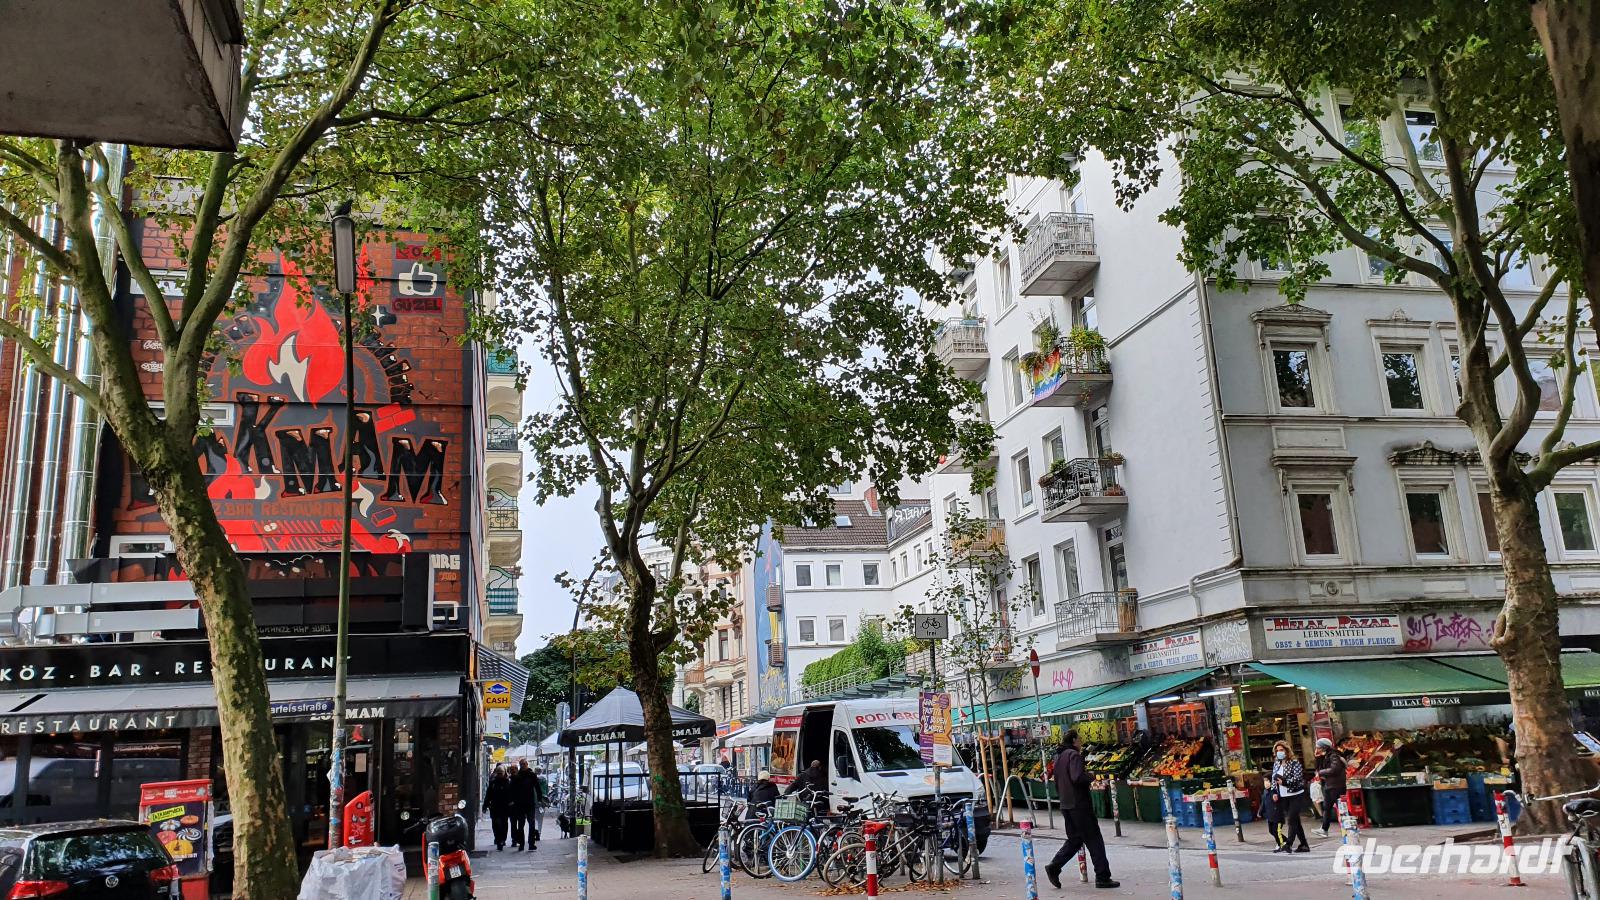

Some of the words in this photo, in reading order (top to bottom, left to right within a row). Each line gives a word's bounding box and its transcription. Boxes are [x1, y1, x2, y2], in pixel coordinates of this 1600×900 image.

[262, 501, 345, 517] RESTAURAN
[1337, 615, 1393, 629] PAZAR
[1303, 629, 1366, 639] LEBENSMITTEL
[1275, 640, 1293, 649] OBST
[1340, 638, 1364, 646] FRISCH
[1367, 637, 1396, 645] FLEISCH
[0, 665, 56, 681] KÖZ
[90, 663, 142, 678] BAR
[174, 656, 352, 675] REURAN
[270, 702, 328, 714] artelsstraße
[1392, 699, 1421, 707] HELAL
[1431, 697, 1461, 705] BAZAR
[855, 713, 891, 724] RODI
[896, 712, 920, 720] BRO
[0, 716, 177, 734] RESTAURANT
[672, 727, 701, 737] KMAM
